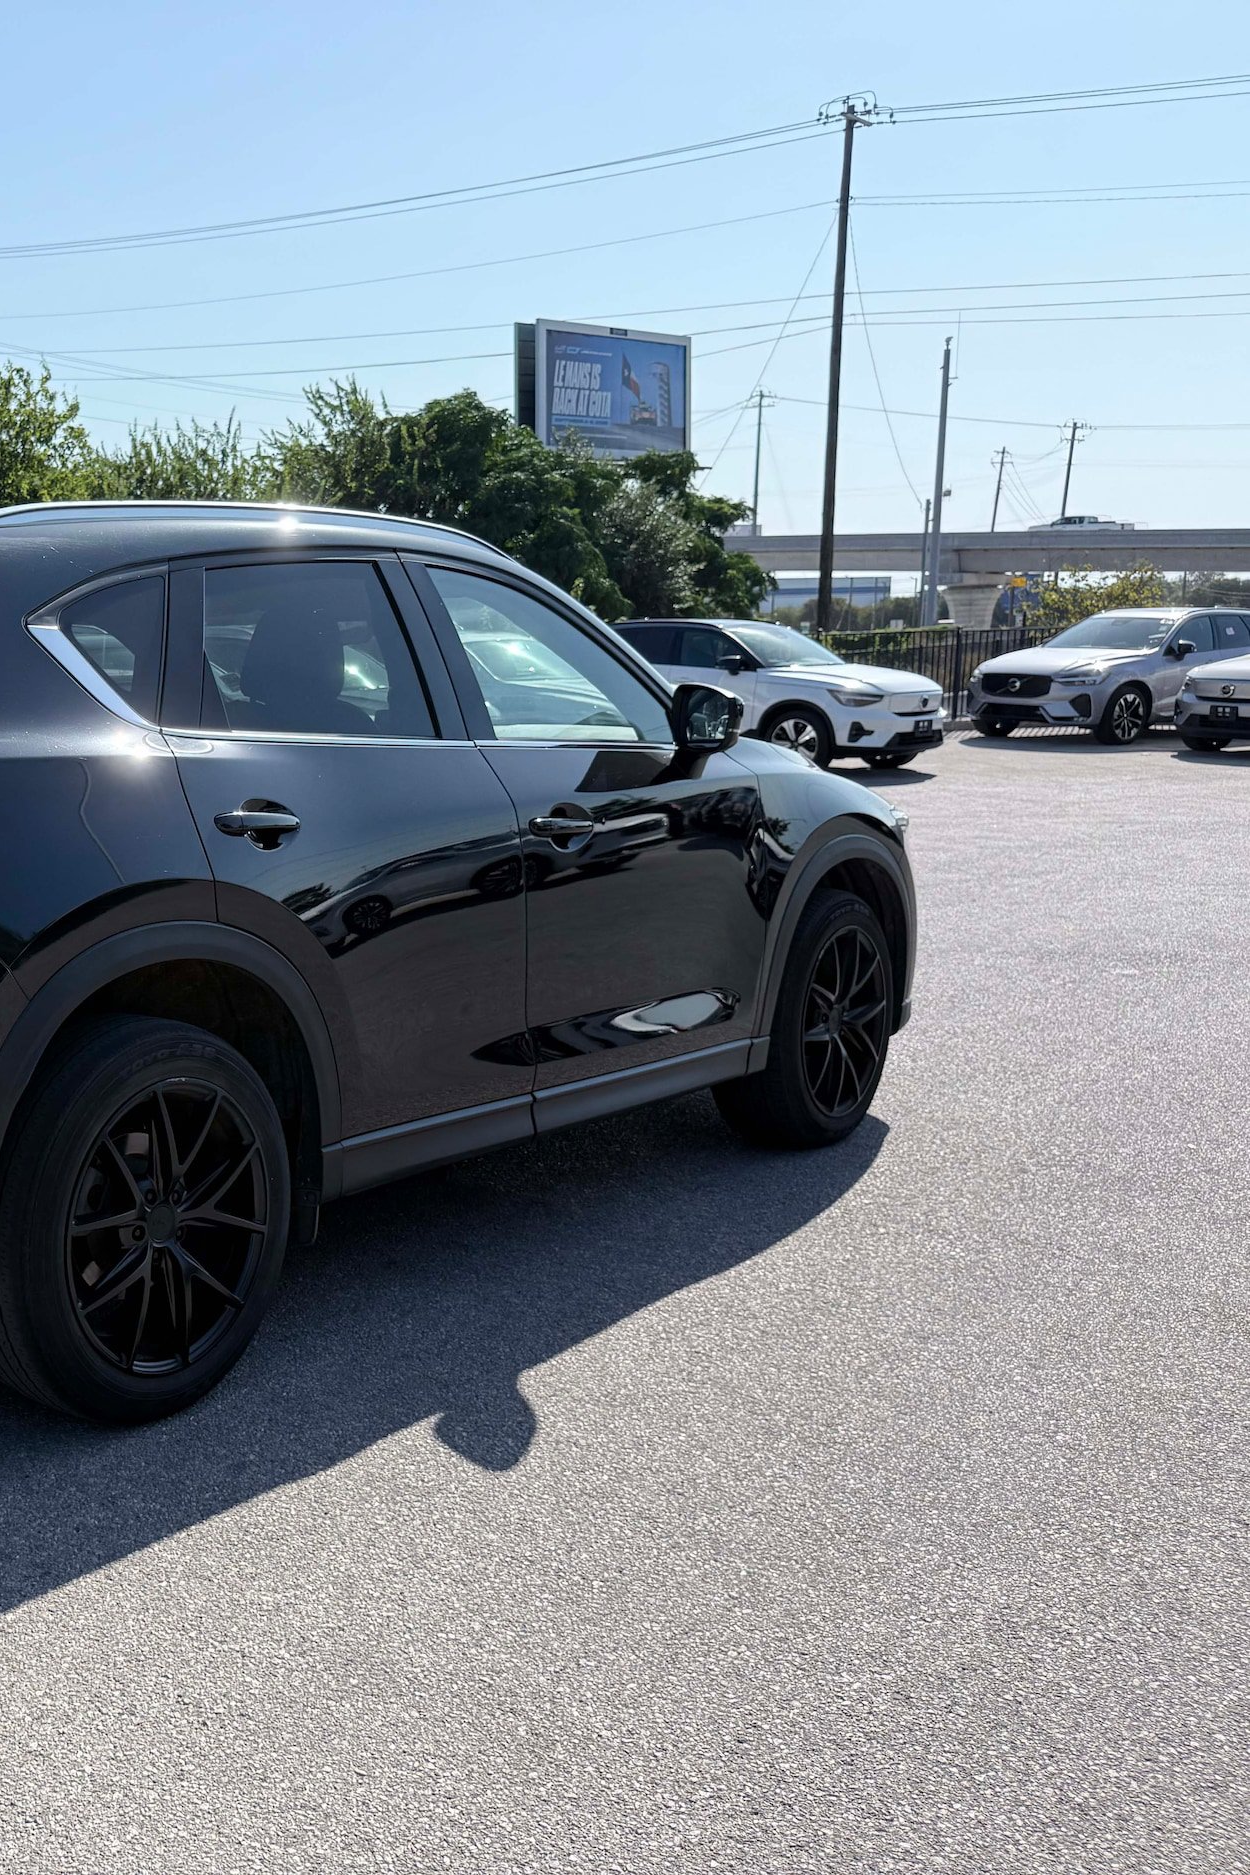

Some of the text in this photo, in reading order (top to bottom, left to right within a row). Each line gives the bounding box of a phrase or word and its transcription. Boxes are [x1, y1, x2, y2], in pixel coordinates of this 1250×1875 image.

[554, 359, 602, 390] LE MANS IS
[552, 387, 612, 417] BACK AT COTA
